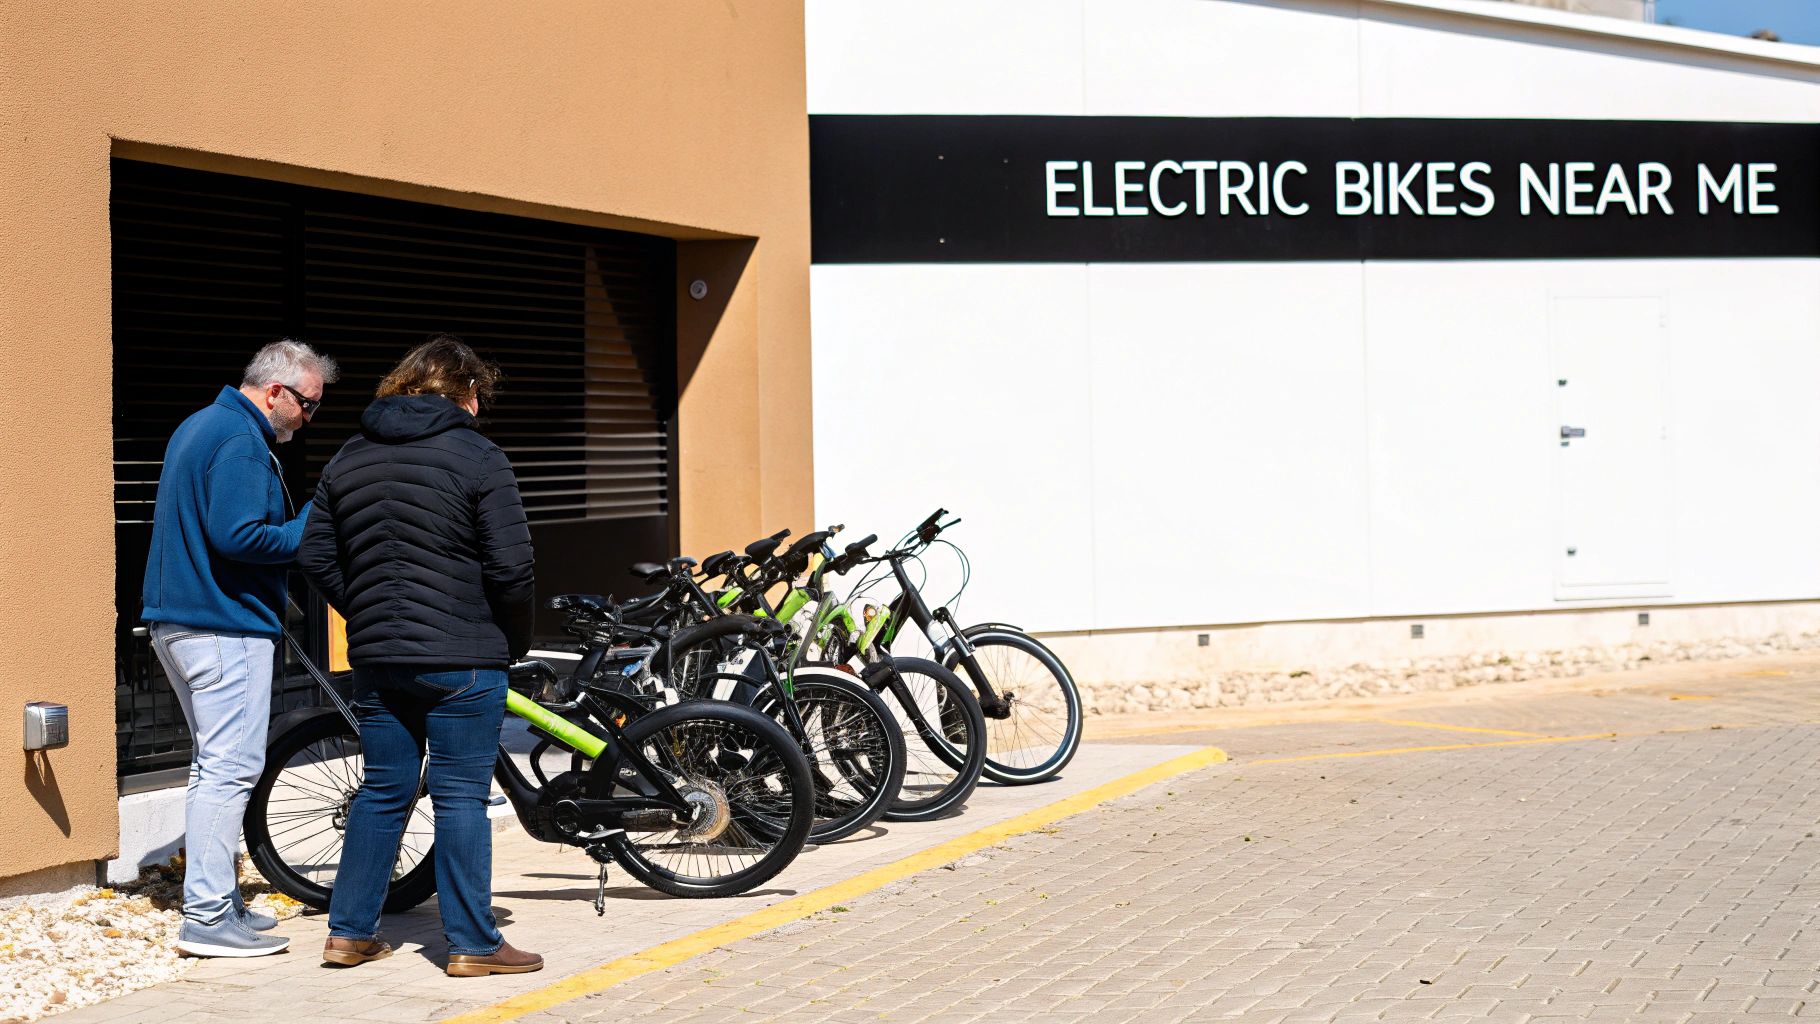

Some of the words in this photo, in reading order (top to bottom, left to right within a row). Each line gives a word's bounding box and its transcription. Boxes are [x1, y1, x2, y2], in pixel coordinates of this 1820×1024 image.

[1045, 160, 1309, 217] ELECTRIC
[1335, 161, 1495, 217] BIKES
[1519, 162, 1674, 216] NEAR
[1697, 163, 1780, 215] ME
